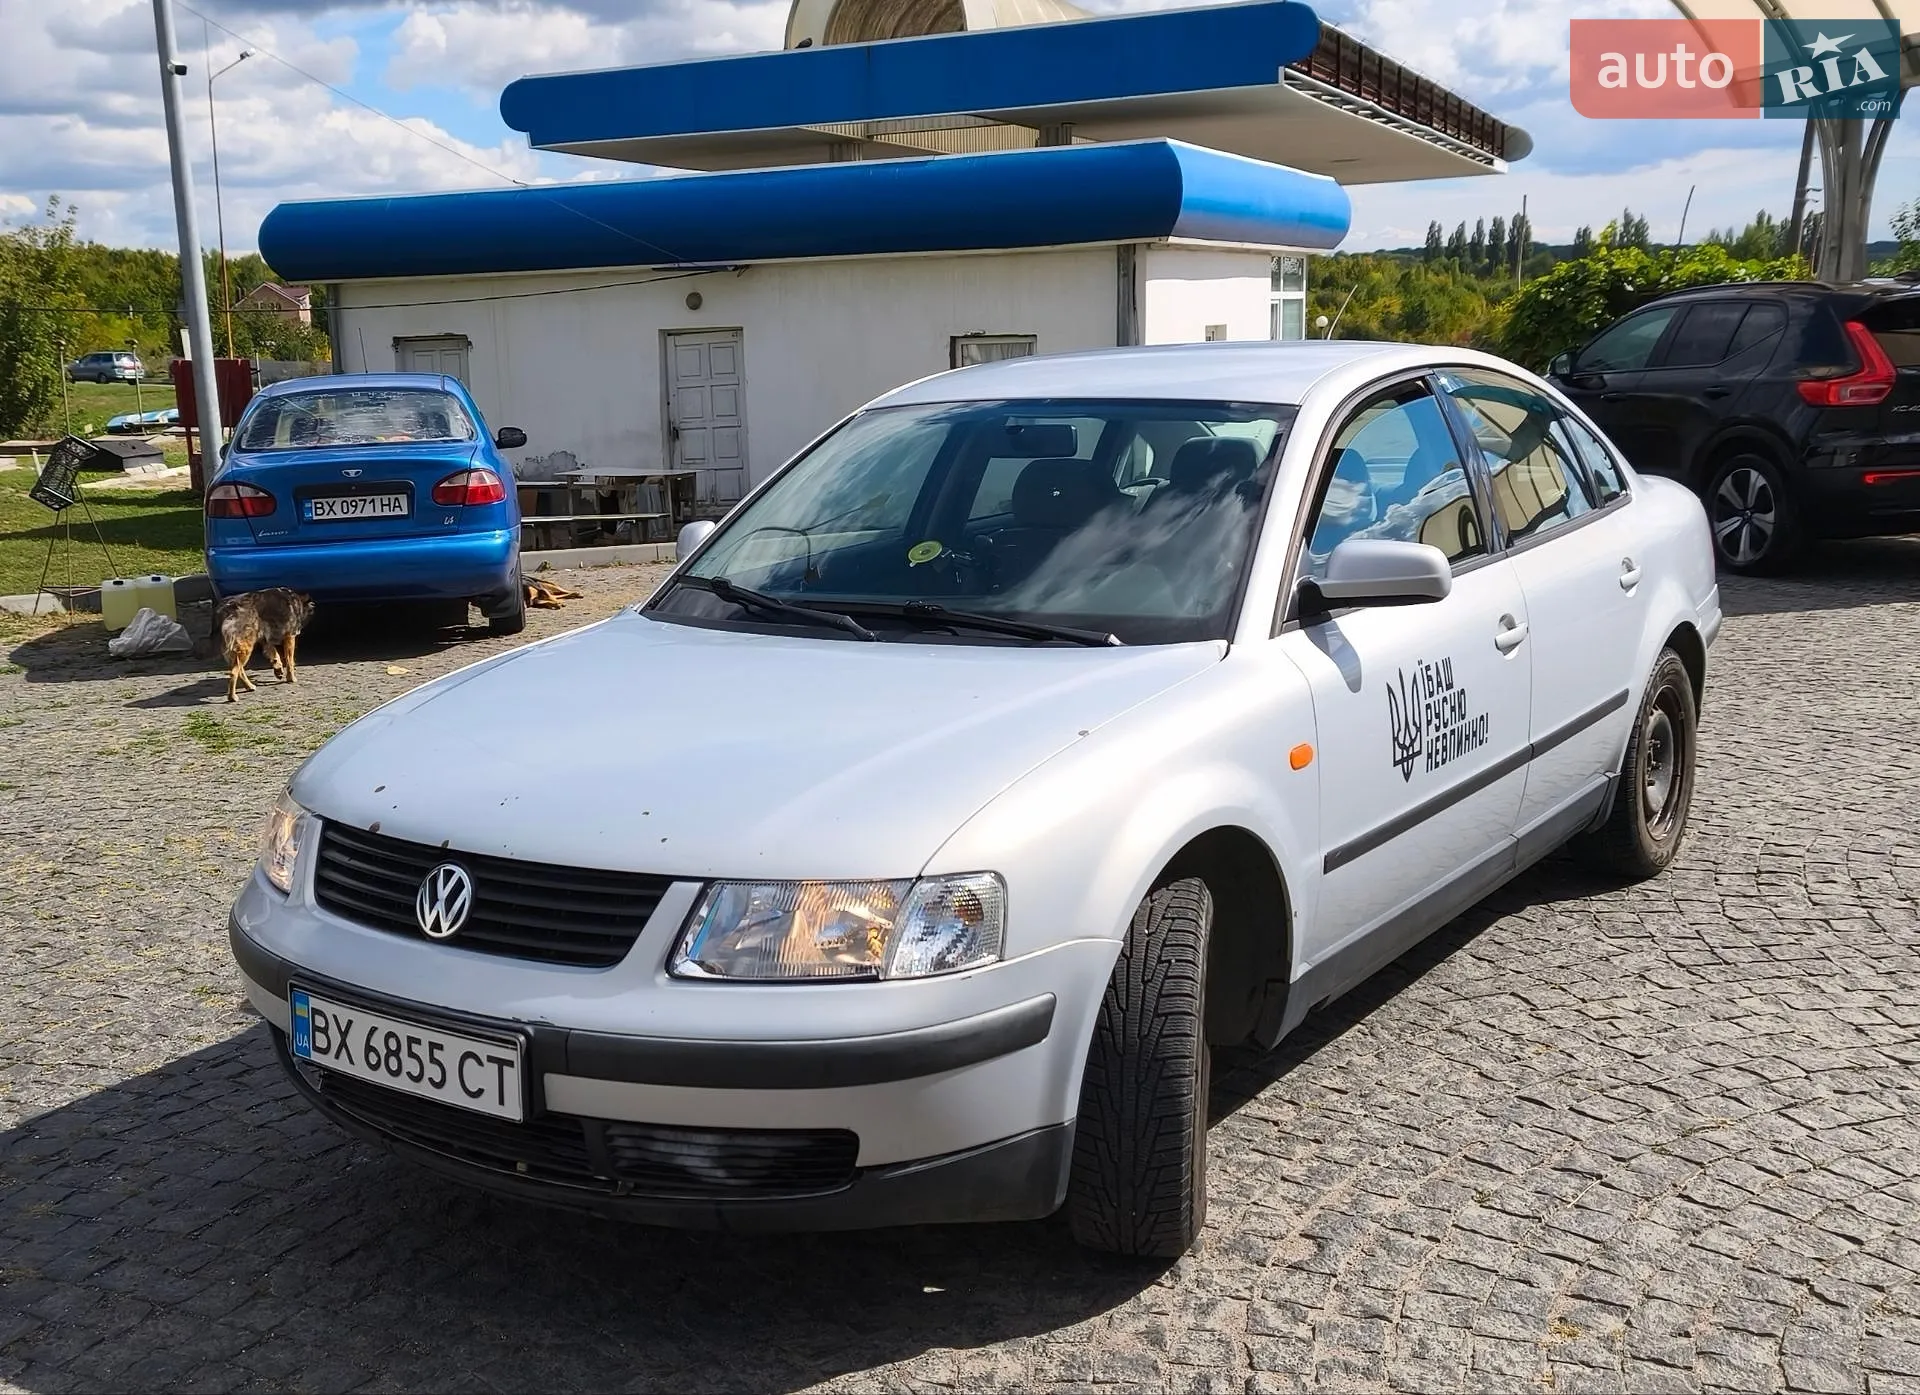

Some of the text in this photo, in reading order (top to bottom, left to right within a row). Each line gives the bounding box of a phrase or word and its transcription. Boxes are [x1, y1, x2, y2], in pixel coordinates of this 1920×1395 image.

[314, 496, 403, 517] BX 0971 HA
[1418, 657, 1454, 700] ЇБАШ
[1425, 688, 1466, 737] РУСНЮ
[1425, 712, 1489, 773] НЕВПИННО!
[296, 1031, 309, 1049] UA
[311, 1007, 515, 1106] BX 6855 CT
